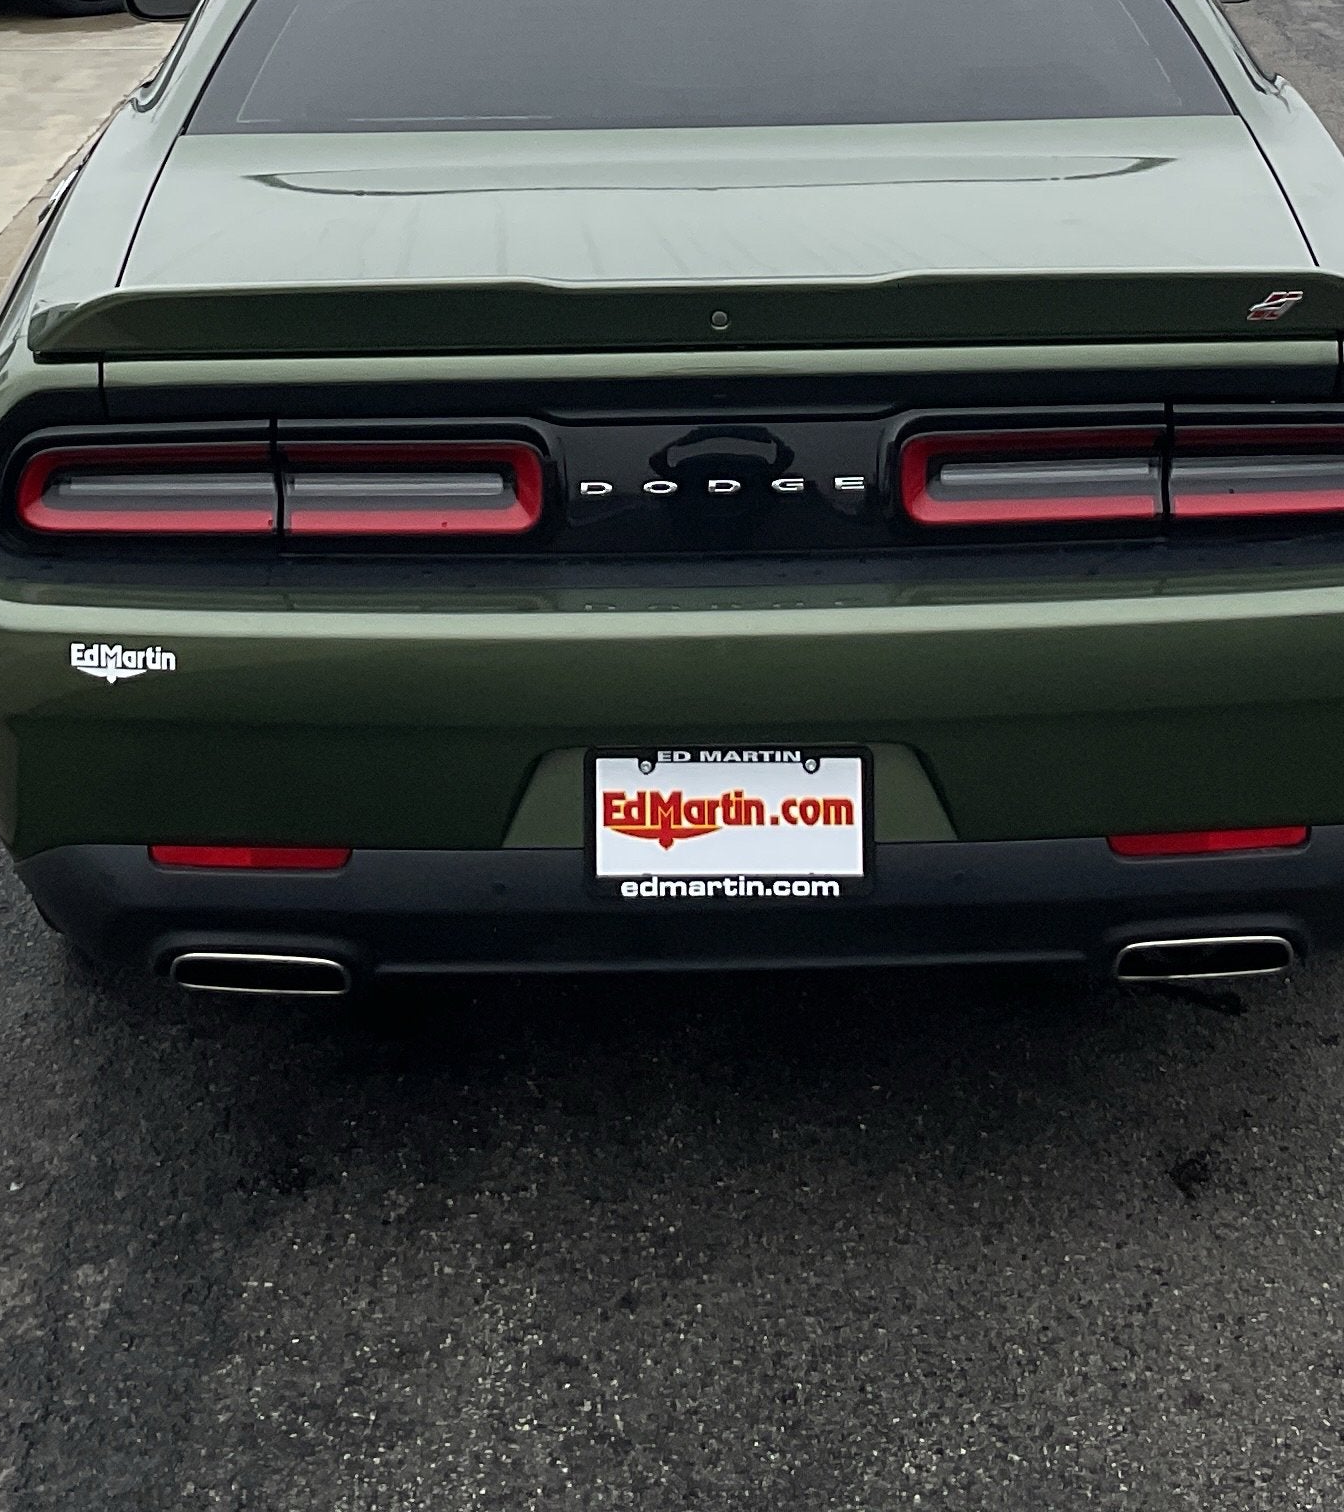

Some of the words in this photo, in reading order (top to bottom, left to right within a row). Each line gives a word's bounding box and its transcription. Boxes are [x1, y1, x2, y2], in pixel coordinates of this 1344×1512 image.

[580, 475, 865, 495] DODGE
[70, 642, 176, 671] EdMartin
[657, 750, 692, 763] ED
[699, 750, 802, 763] MARTIN
[620, 875, 840, 898] edmartin.com
